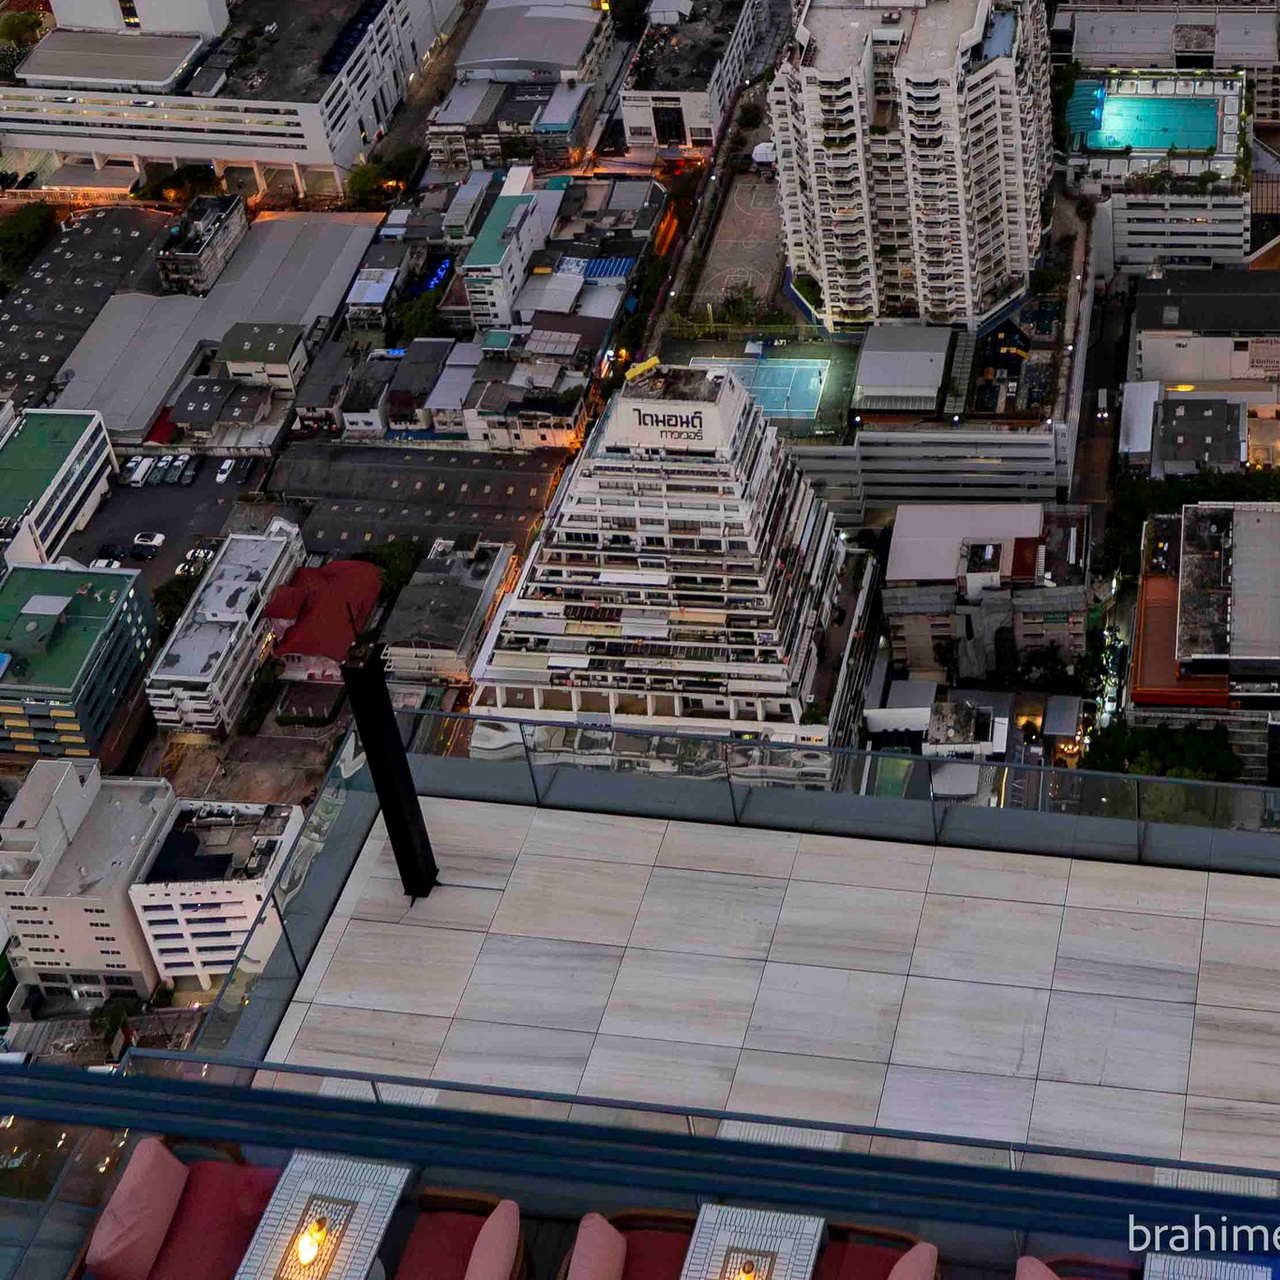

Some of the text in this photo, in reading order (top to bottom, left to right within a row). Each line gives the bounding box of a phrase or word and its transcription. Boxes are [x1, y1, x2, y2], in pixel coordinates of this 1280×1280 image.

[632, 408, 703, 428] ไดมอนด์
[660, 429, 703, 441] ทาวเวอร์
